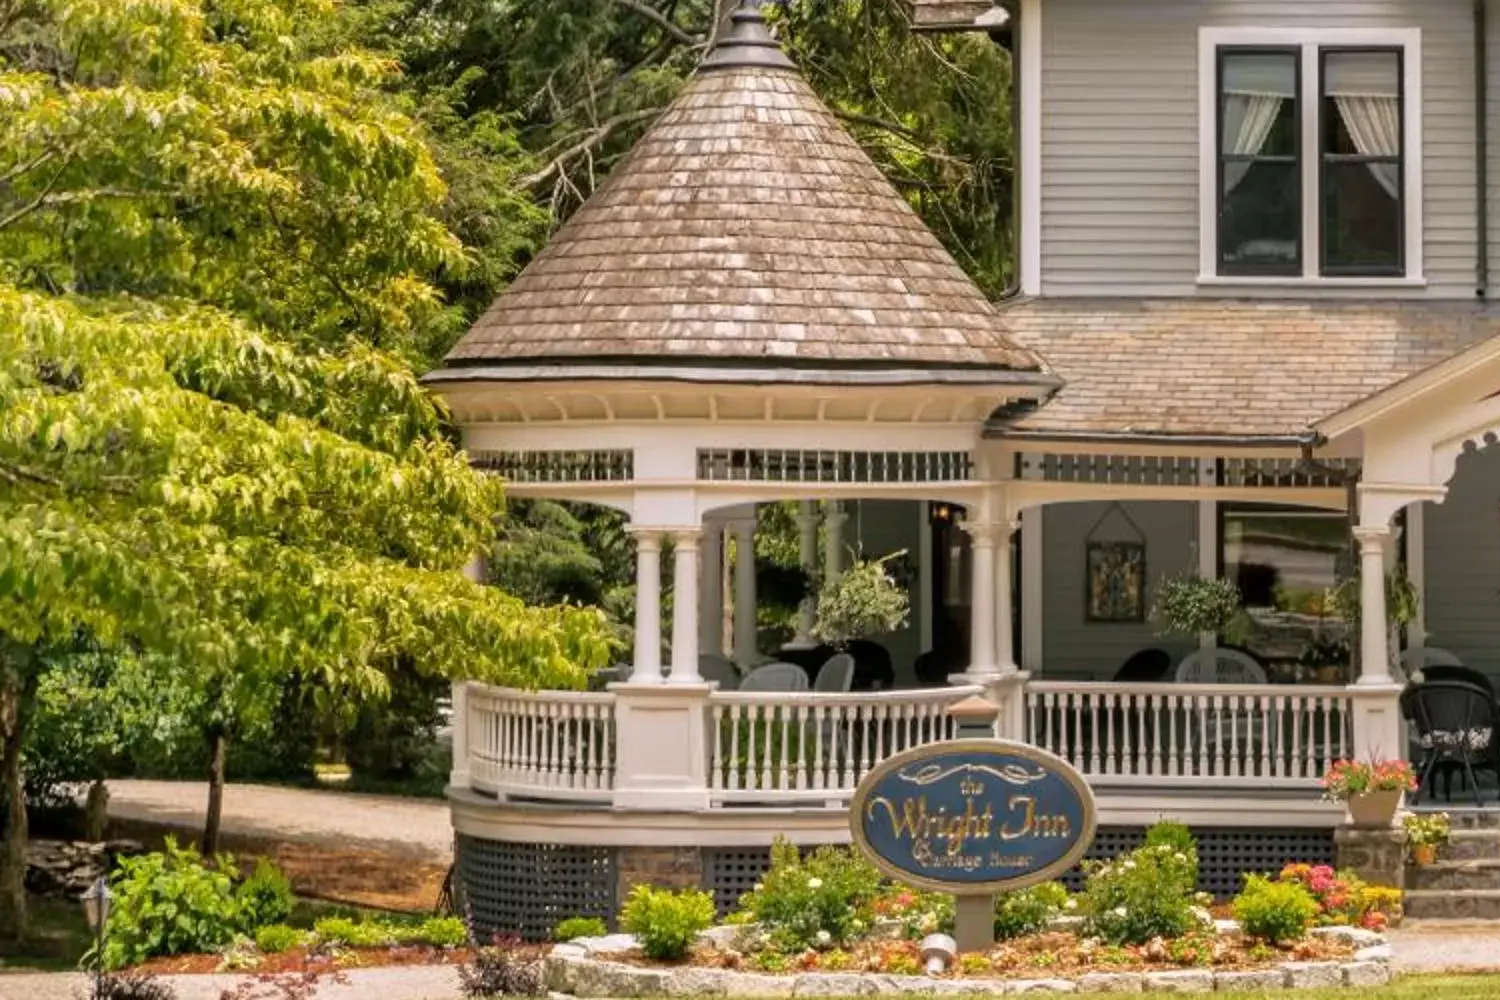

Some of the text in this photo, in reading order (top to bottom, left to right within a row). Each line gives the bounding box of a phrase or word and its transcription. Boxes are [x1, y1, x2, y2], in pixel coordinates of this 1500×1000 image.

[960, 775, 985, 796] the
[867, 794, 1072, 856] Wright Inn
